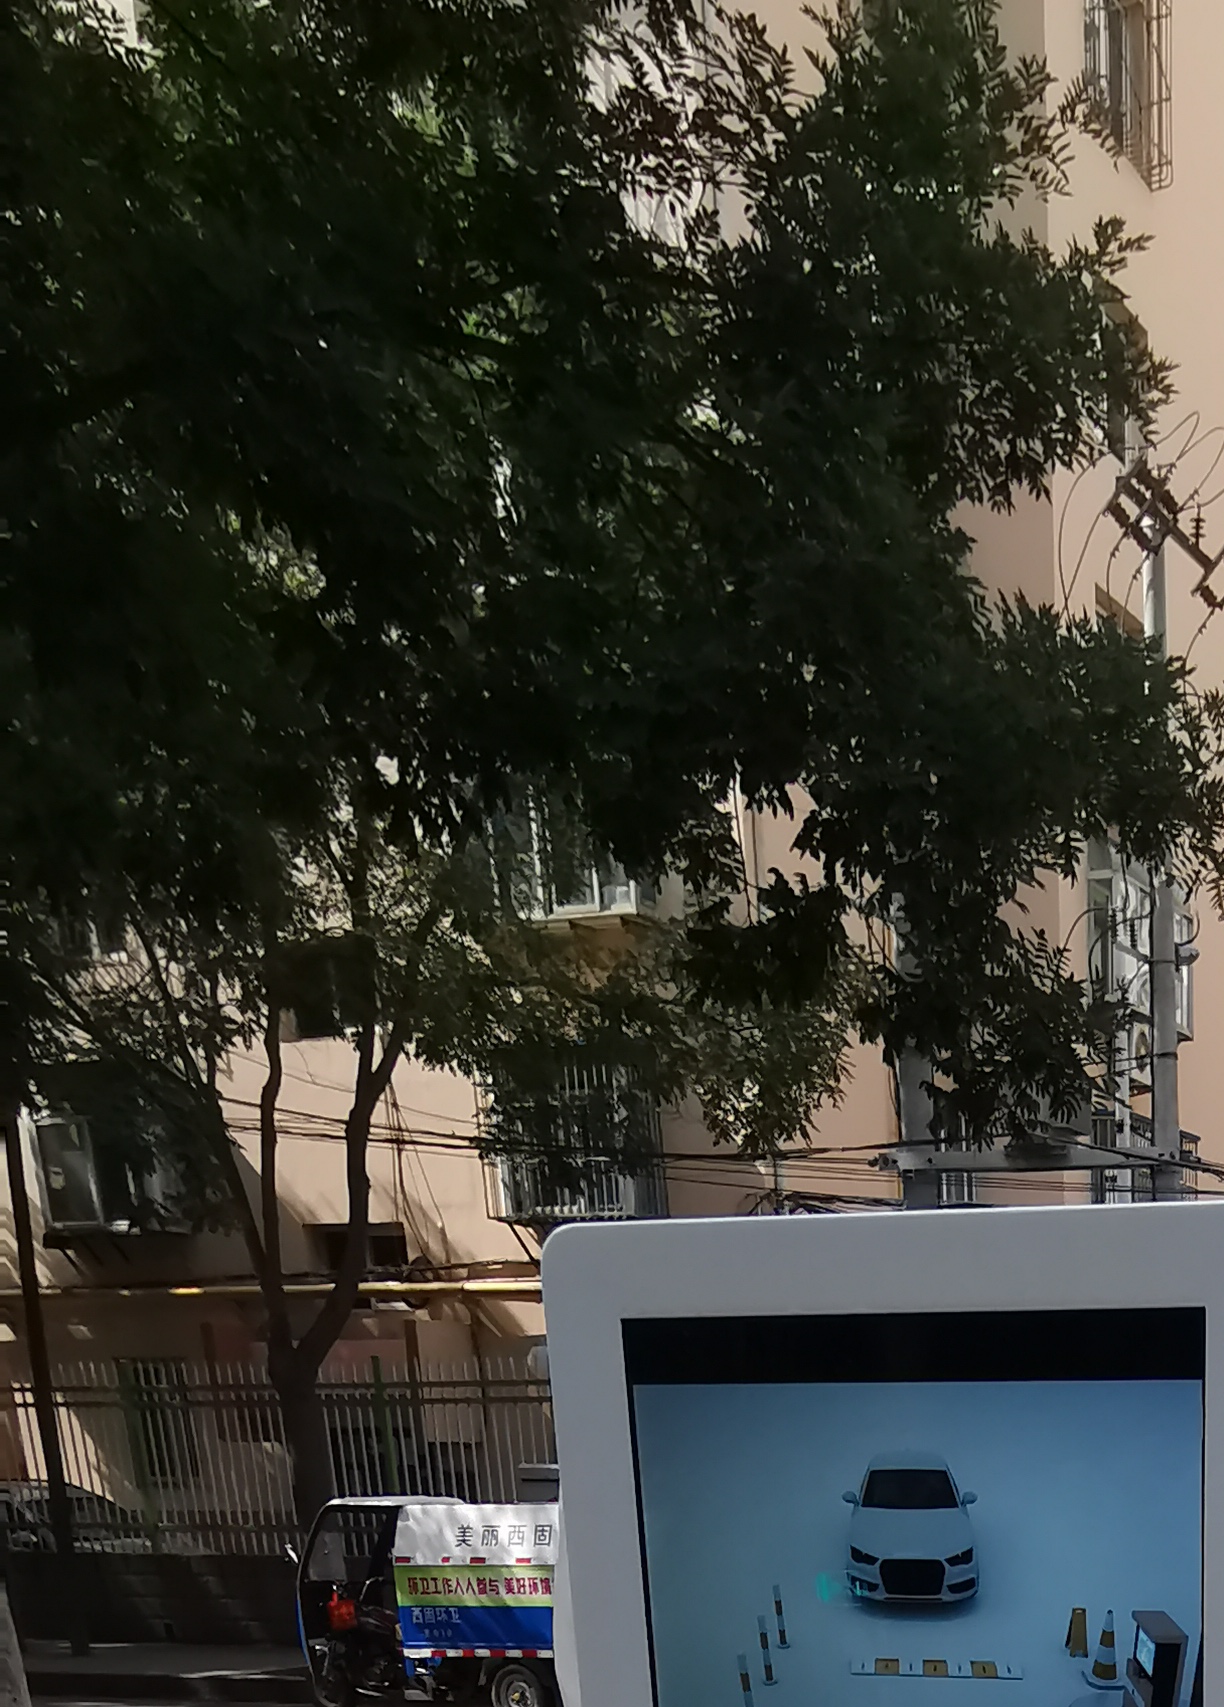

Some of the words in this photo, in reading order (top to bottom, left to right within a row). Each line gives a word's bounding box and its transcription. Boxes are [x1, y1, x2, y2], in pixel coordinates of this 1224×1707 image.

[455, 1523, 553, 1547] 美丽西固
[411, 1607, 461, 1624] 西固环卫
